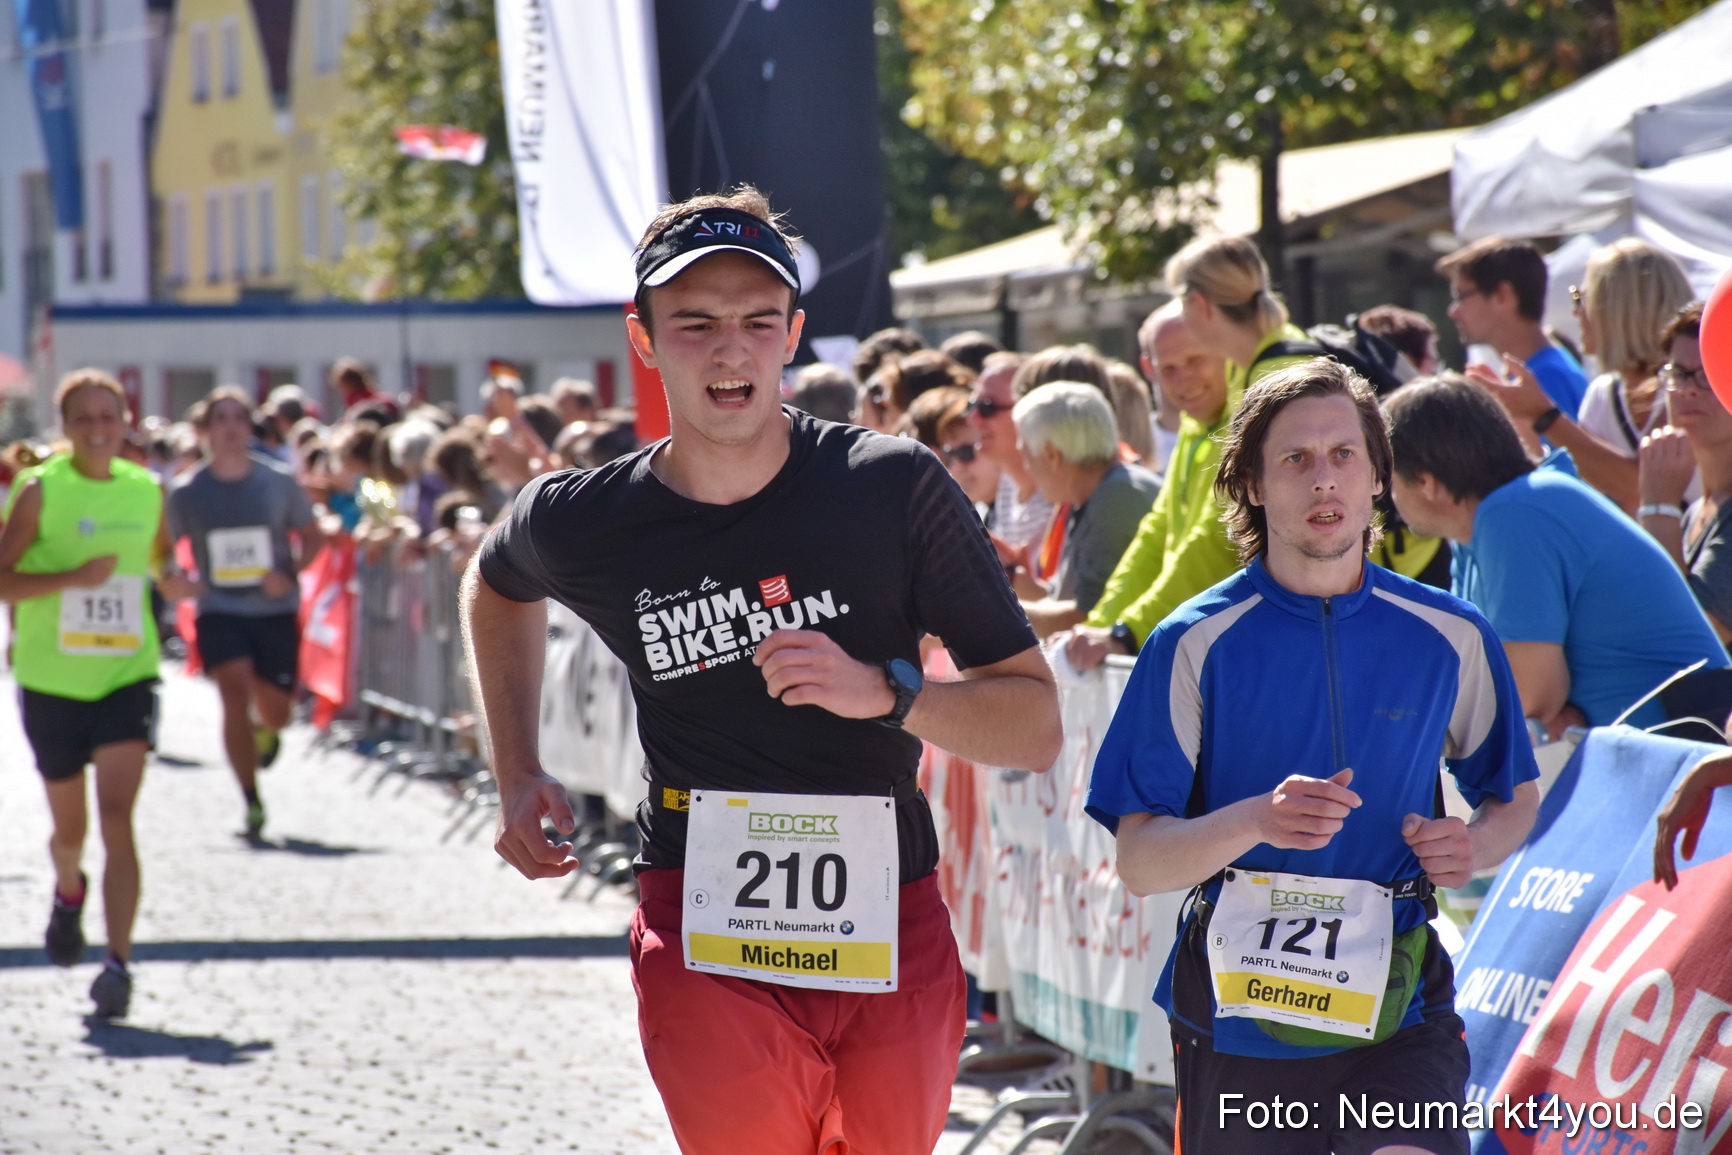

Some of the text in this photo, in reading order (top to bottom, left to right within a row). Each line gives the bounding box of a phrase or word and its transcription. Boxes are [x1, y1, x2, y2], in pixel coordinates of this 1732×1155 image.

[634, 576, 722, 613] Born to
[83, 599, 124, 622] 151
[638, 587, 761, 643] SWIM.
[652, 651, 741, 682] COMPRESSPORT
[748, 812, 839, 835] BOCK
[747, 833, 775, 843] inspired
[777, 834, 786, 843] by
[809, 836, 840, 844] concepts
[734, 850, 848, 912] 210
[1508, 866, 1595, 914] STORE
[695, 893, 703, 904] C
[1271, 889, 1346, 911] BOCK
[728, 918, 835, 933] PARTL Neumarkt
[1257, 916, 1343, 961] 121
[1216, 936, 1223, 945] B
[741, 943, 838, 971] Michael
[1240, 955, 1333, 980] PARTL Neumarkt
[1247, 977, 1332, 1013] Gerhard
[1455, 967, 1553, 1024] ONLINE
